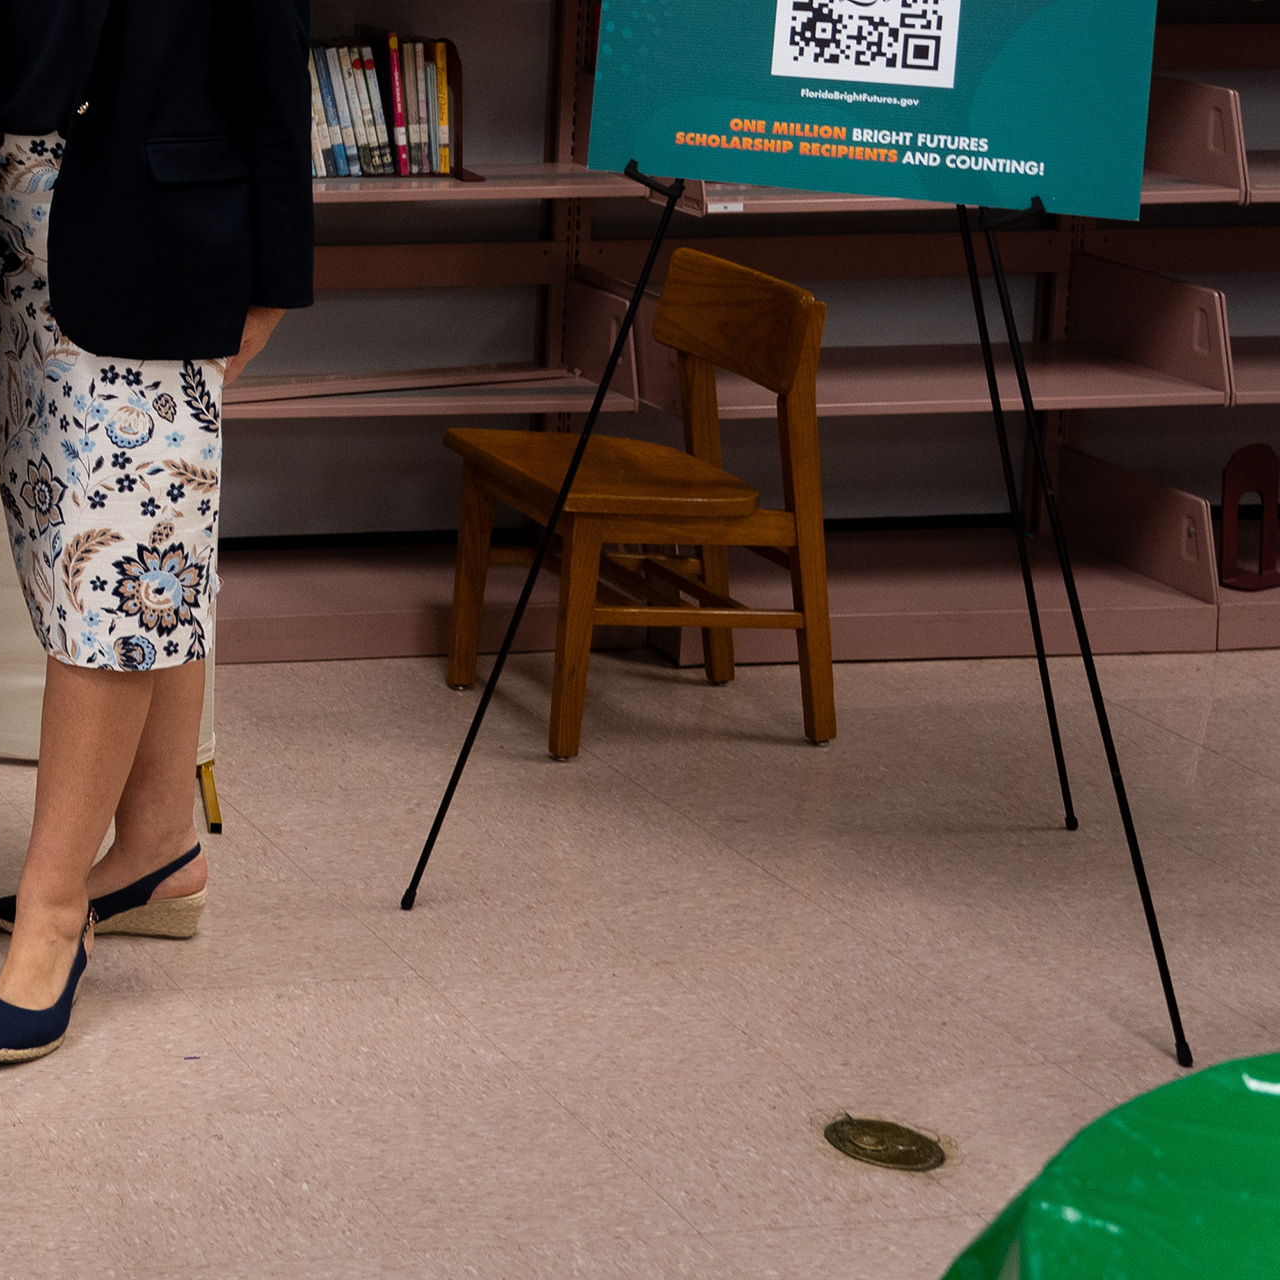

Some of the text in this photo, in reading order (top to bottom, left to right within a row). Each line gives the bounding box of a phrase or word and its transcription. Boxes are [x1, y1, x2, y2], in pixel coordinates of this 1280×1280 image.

[801, 88, 919, 108] FloridaBrightFutures.gov
[730, 118, 988, 152] ONE MILLION BRIGHT FUTURES
[675, 132, 1044, 176] SCHOLARSHIP RECIPIENTS AND COUNTING!
